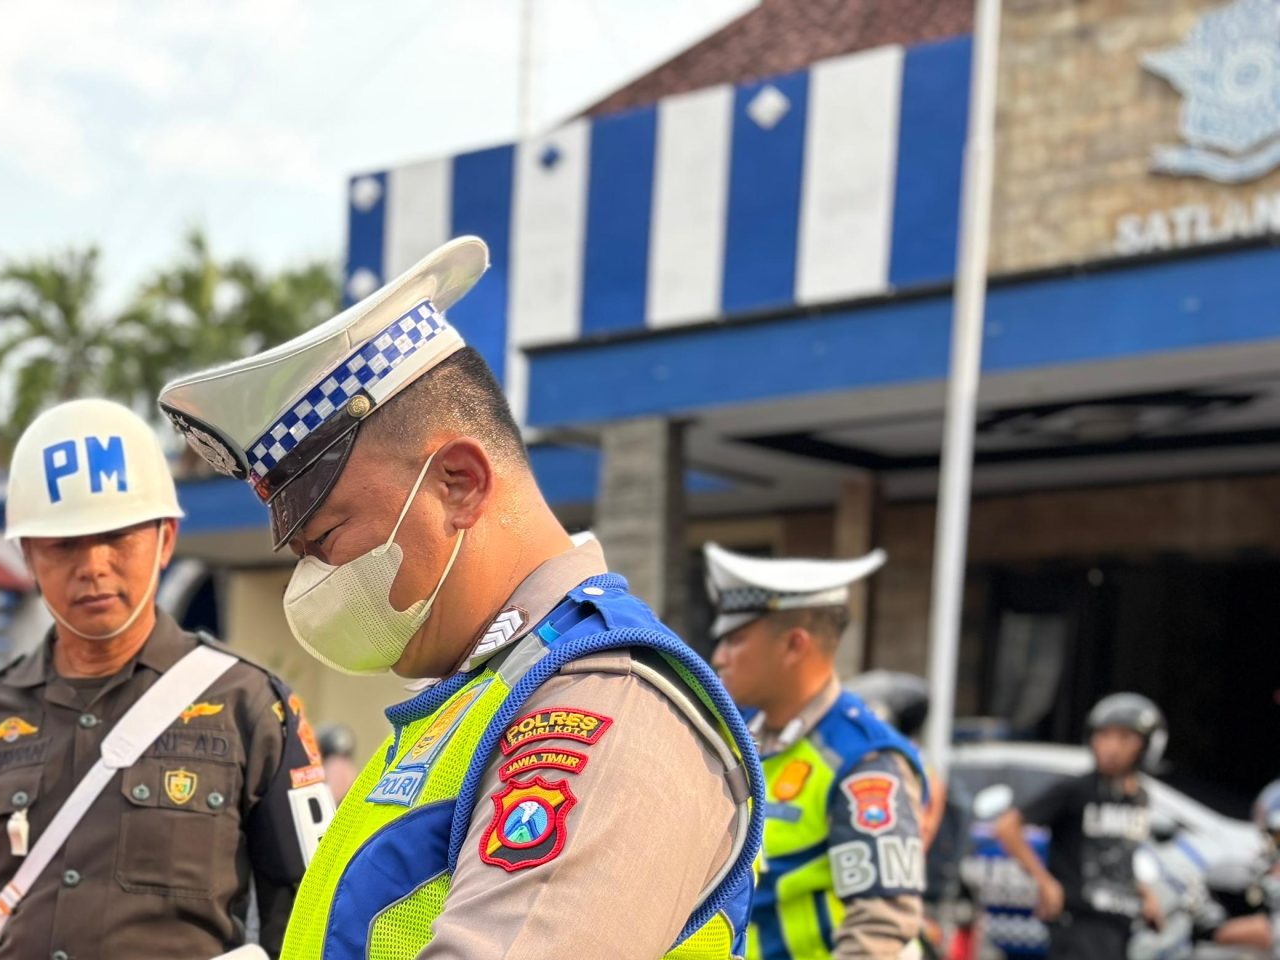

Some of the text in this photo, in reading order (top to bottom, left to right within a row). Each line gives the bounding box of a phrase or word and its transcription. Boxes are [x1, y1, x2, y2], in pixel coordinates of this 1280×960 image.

[43, 436, 127, 503] PM
[506, 711, 598, 743] POLRES
[510, 726, 589, 747] KEDIRI KOTA
[507, 753, 581, 774] JAWA TIMUR
[374, 776, 418, 796] POLRI
[828, 836, 926, 899] BM
